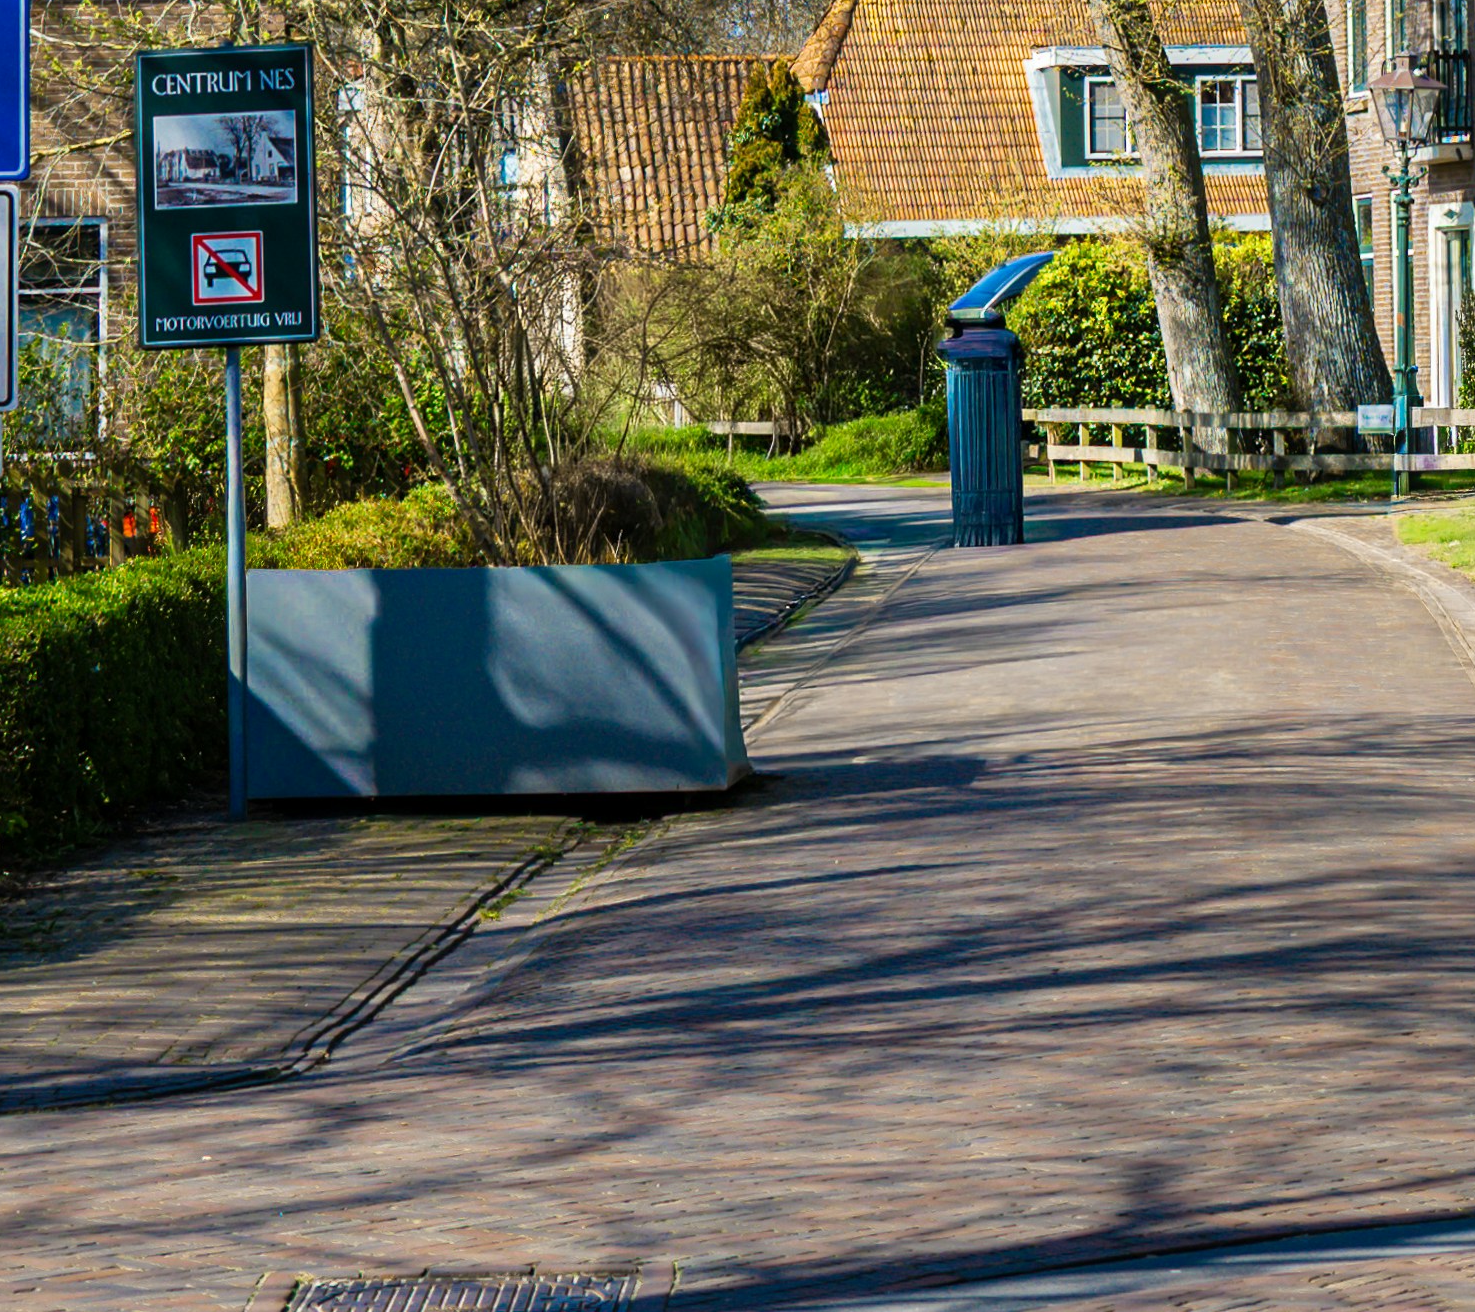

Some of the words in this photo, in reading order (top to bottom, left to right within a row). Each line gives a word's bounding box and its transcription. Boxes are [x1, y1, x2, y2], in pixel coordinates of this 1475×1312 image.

[151, 70, 251, 96] CENTRUM
[258, 67, 295, 90] NES
[155, 312, 270, 332] MOTORVOERTUIG
[274, 311, 302, 326] VRIJ
